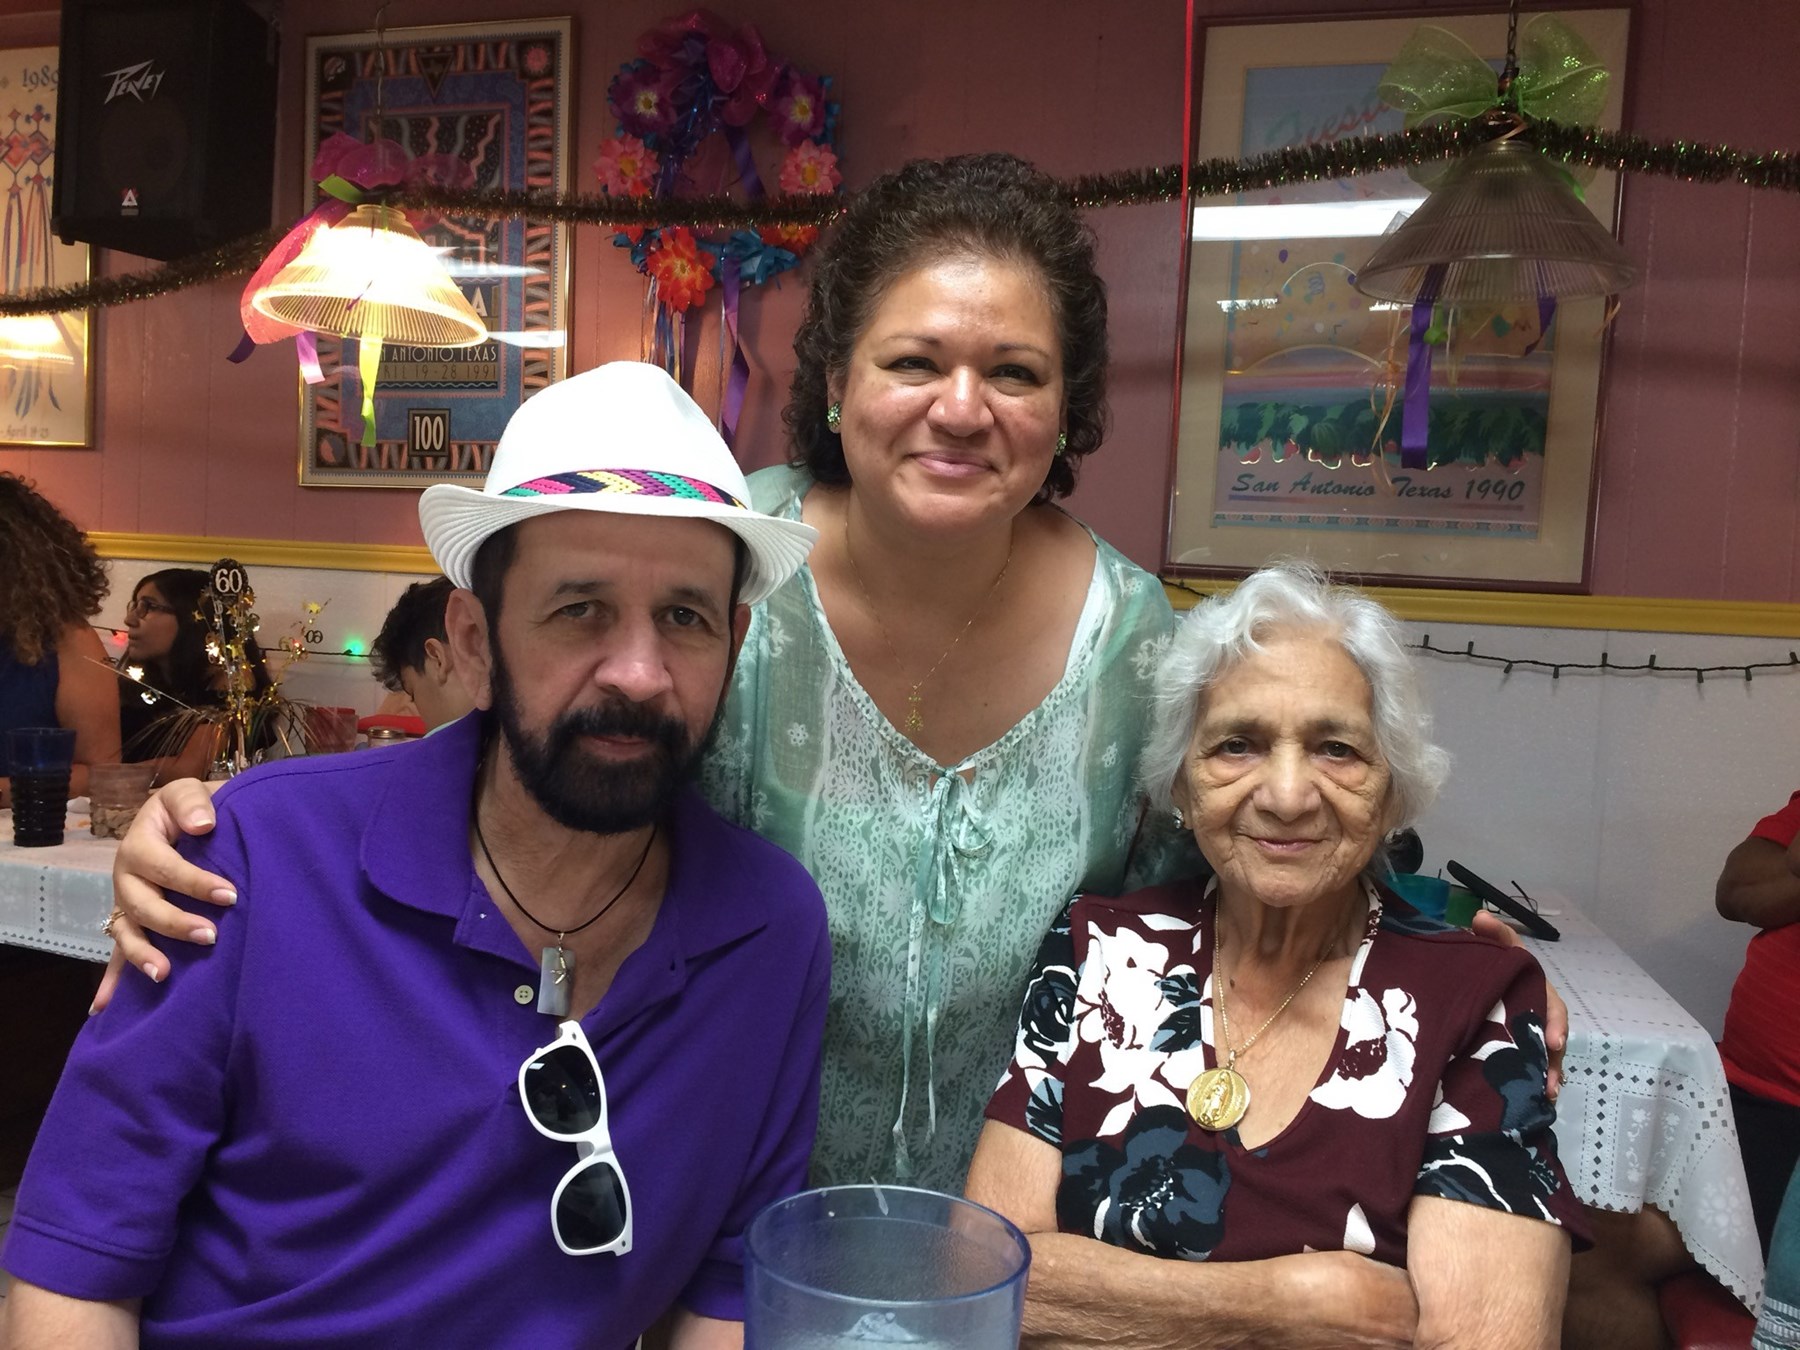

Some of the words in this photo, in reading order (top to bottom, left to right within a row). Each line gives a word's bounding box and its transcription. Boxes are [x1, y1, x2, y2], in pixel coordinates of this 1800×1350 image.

[102, 59, 167, 104] PEAVEY
[467, 364, 496, 380] 1991
[414, 415, 444, 451] 100
[1231, 472, 1280, 493] San
[1289, 471, 1376, 496] Antonio
[1391, 475, 1454, 499] Texas
[1465, 478, 1526, 501] 1990
[215, 568, 243, 593] 60
